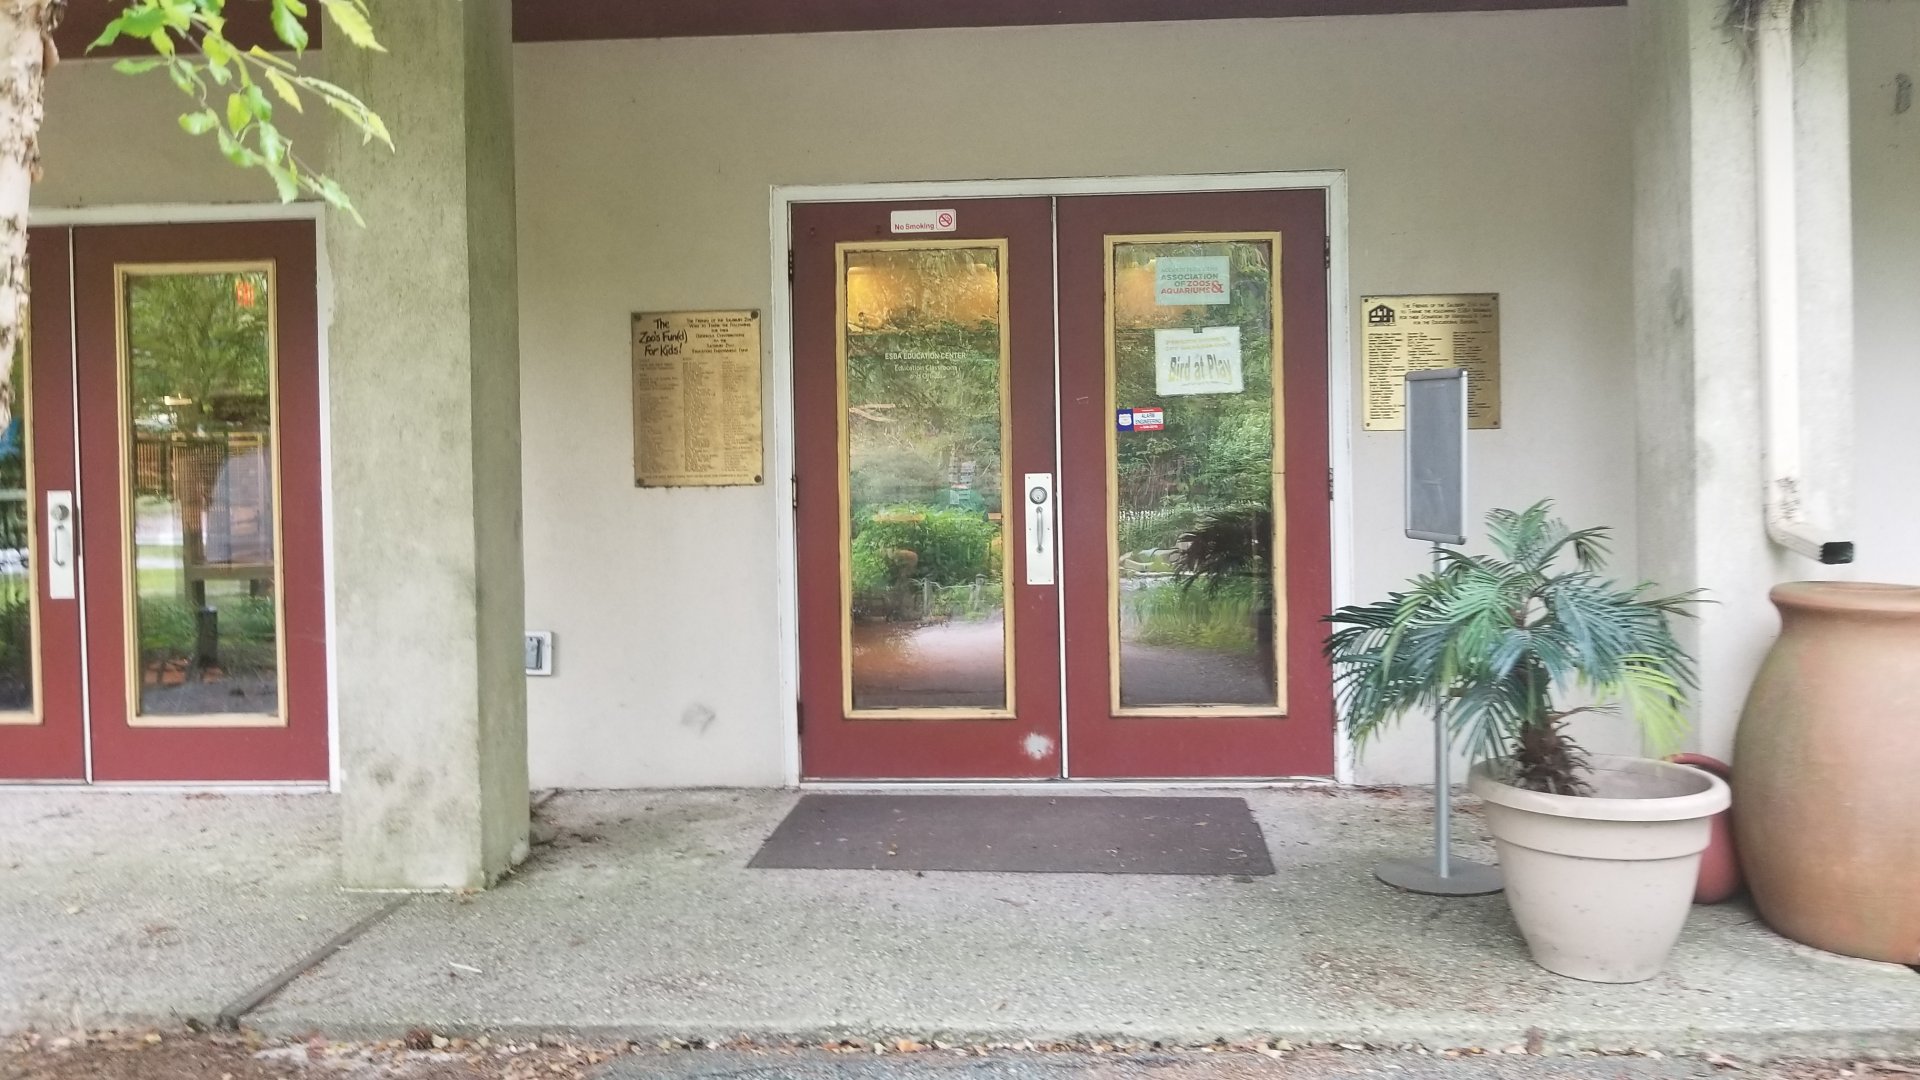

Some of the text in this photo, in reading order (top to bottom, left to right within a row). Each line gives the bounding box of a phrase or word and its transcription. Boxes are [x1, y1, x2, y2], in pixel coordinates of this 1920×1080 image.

[653, 318, 669, 329] The
[639, 329, 688, 344] Zoo's Fun(d)
[644, 343, 682, 357] For Kids!
[1168, 354, 1233, 382] Bird at Play
